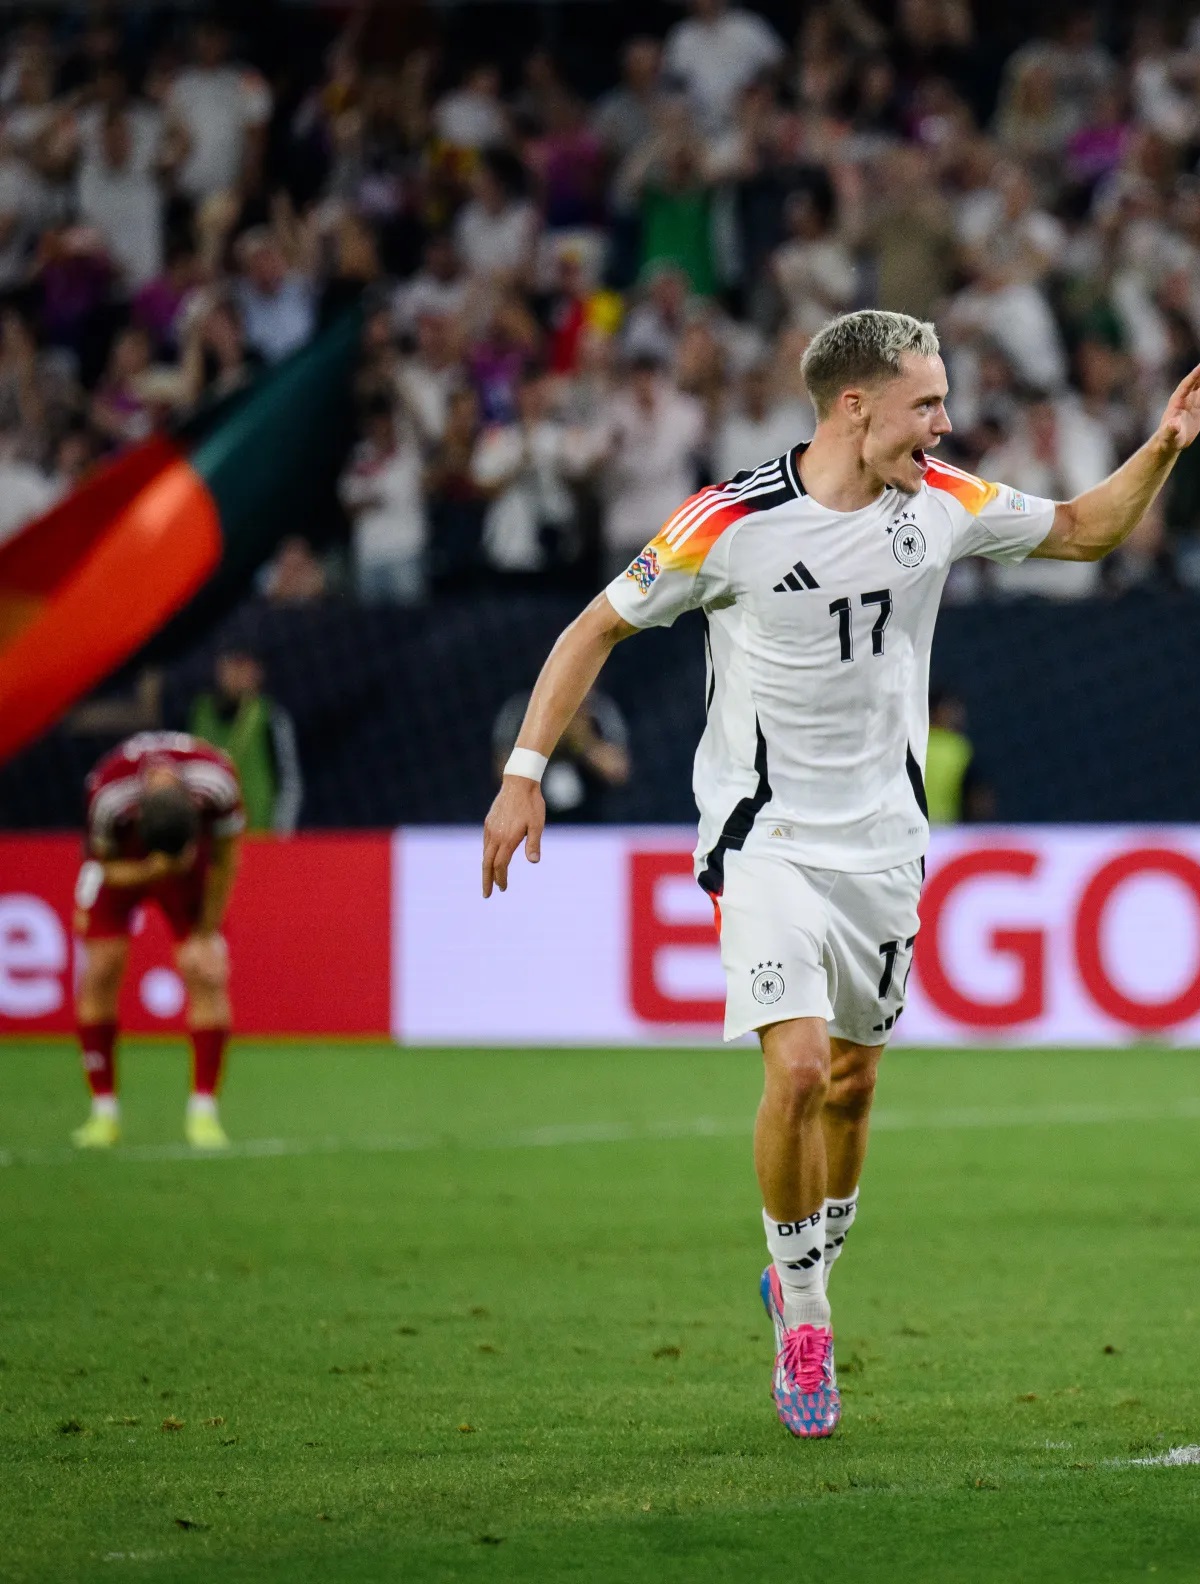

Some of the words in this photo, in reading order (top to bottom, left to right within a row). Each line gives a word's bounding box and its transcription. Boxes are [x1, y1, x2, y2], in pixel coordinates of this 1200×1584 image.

[829, 588, 893, 663] 17
[827, 1201, 858, 1219] DF
[777, 1212, 821, 1237] DFB
